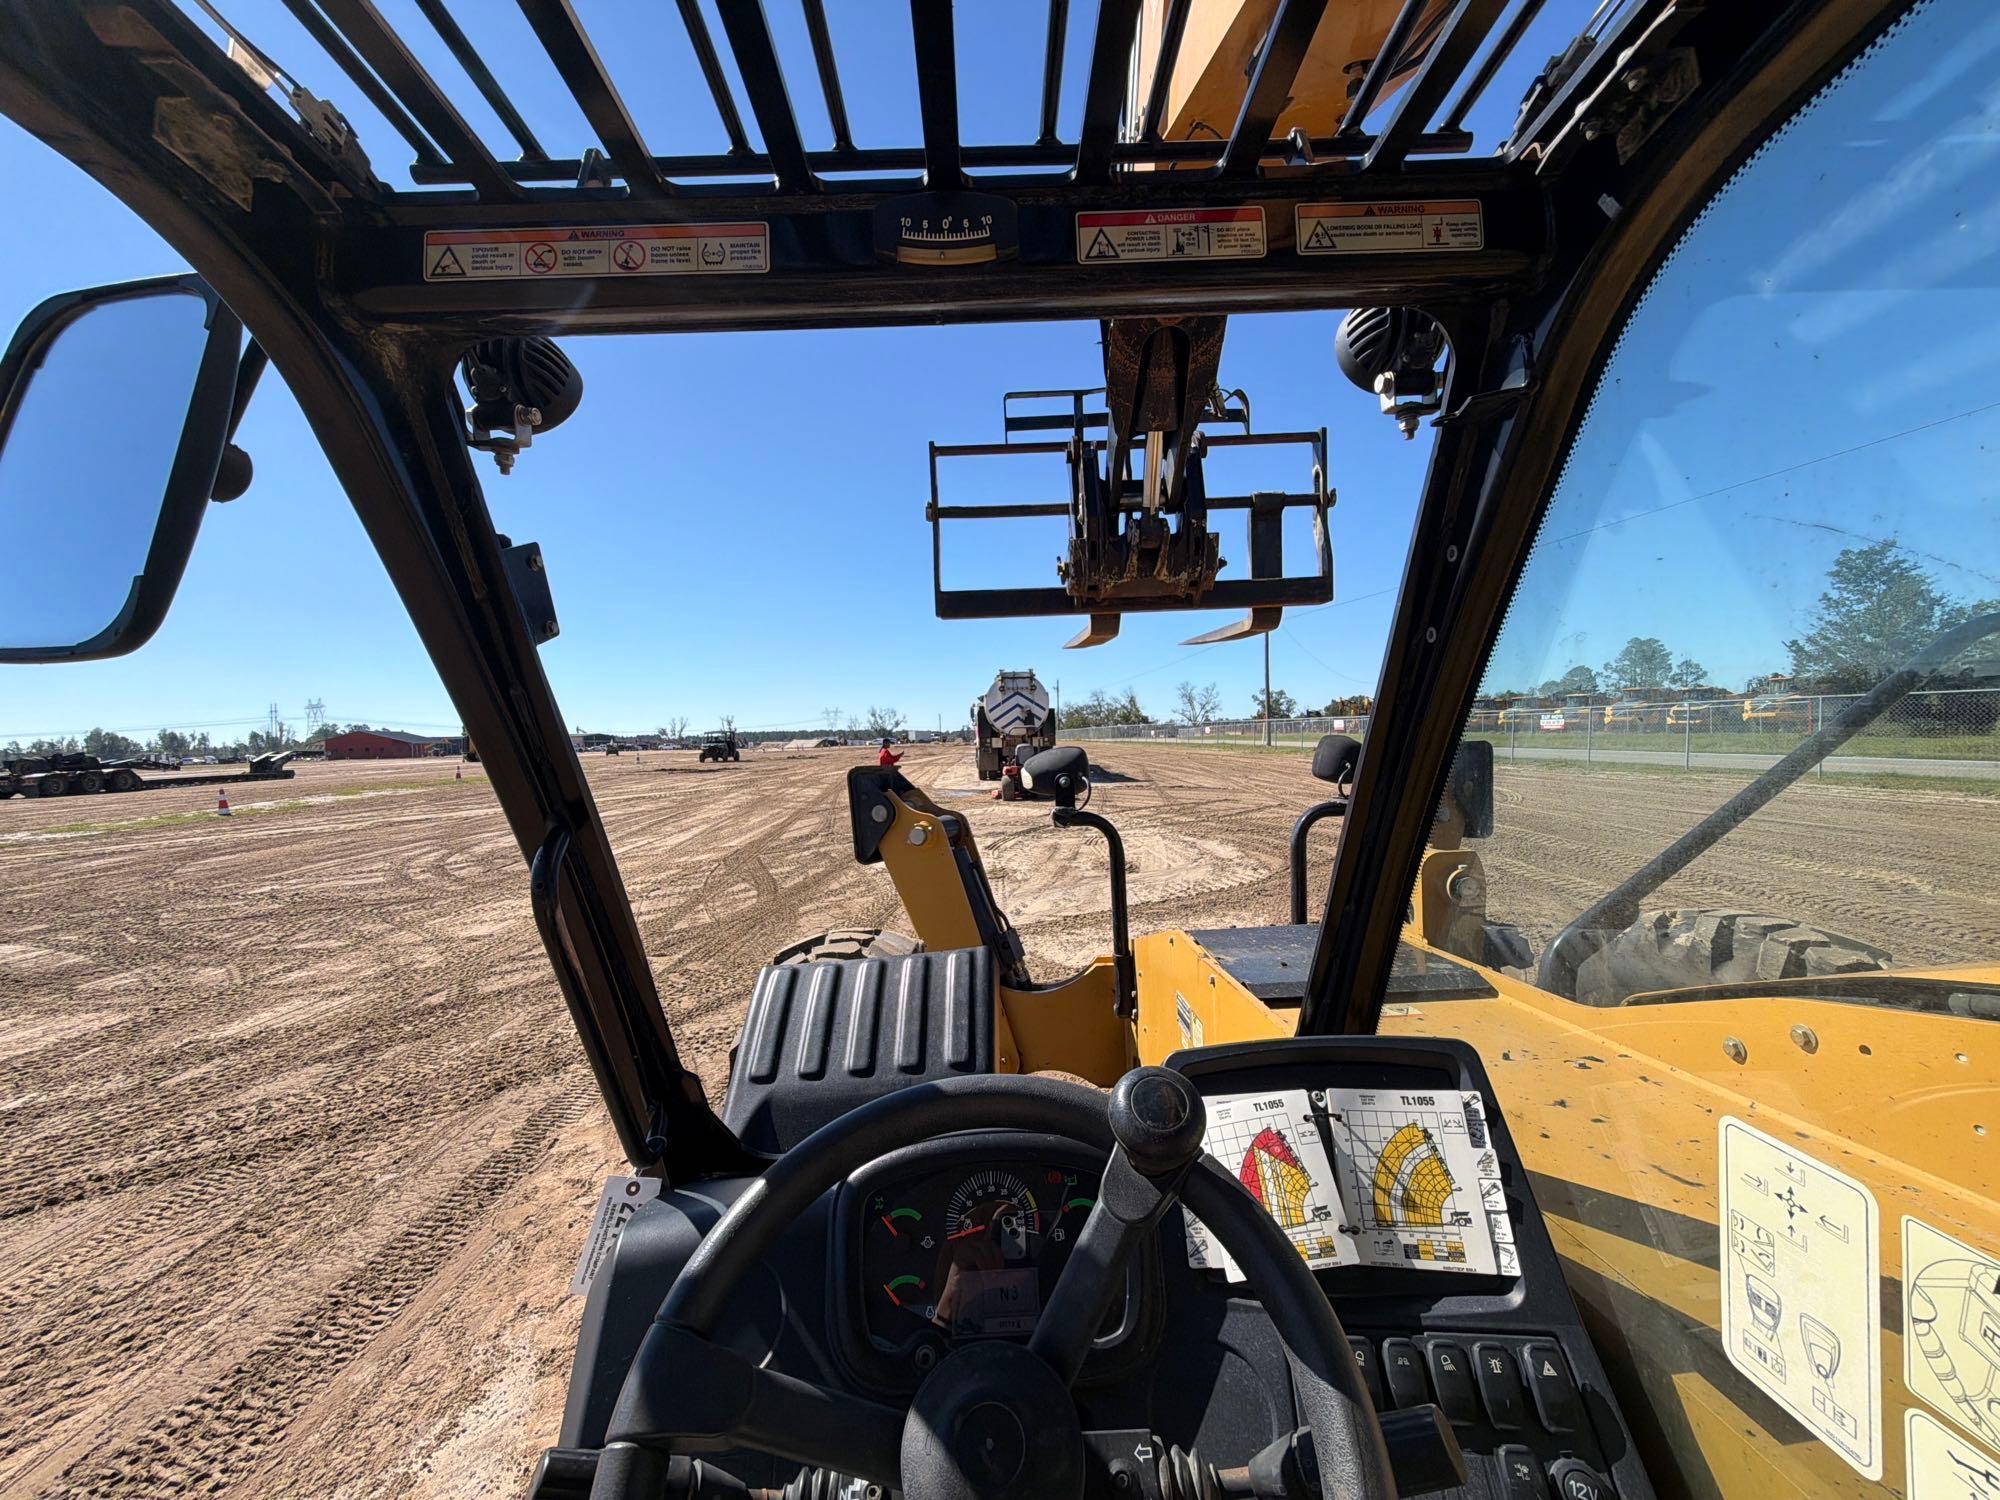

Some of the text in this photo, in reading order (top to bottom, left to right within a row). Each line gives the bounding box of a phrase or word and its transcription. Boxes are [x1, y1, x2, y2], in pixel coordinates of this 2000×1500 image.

[1378, 205, 1424, 214] WARNING
[900, 217, 911, 226] 10
[922, 220, 928, 228] 5
[963, 218, 969, 227] 5
[981, 215, 992, 225] 10
[1157, 213, 1196, 222] DANGER
[581, 230, 625, 239] WARNING
[1253, 1099, 1284, 1112] TL1055
[1400, 1096, 1435, 1106] TL1055
[589, 1204, 617, 1280] REBEL AUCTION COMPANY
[1569, 1480, 1598, 1500] 12V
